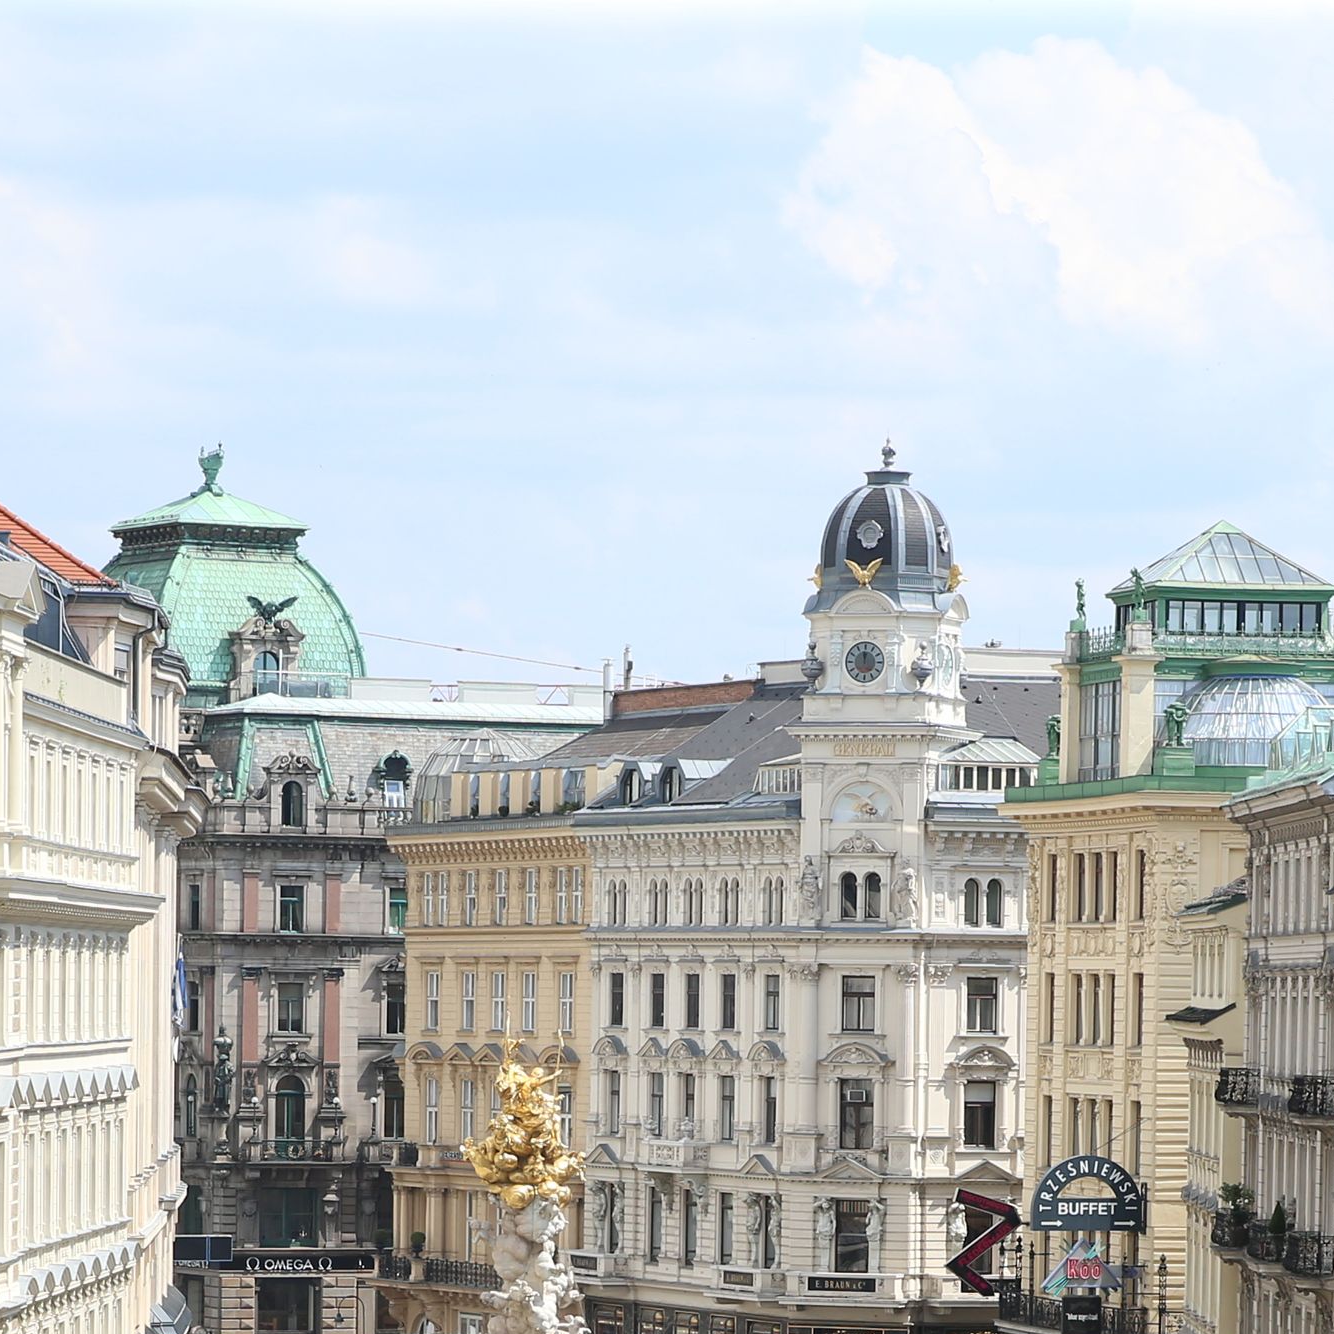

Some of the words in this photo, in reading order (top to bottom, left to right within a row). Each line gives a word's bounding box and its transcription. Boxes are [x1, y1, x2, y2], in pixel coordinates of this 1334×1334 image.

[1057, 1202, 1118, 1216] BUFFET
[264, 1259, 314, 1271] OMEGA
[825, 1281, 851, 1290] BRAUN
